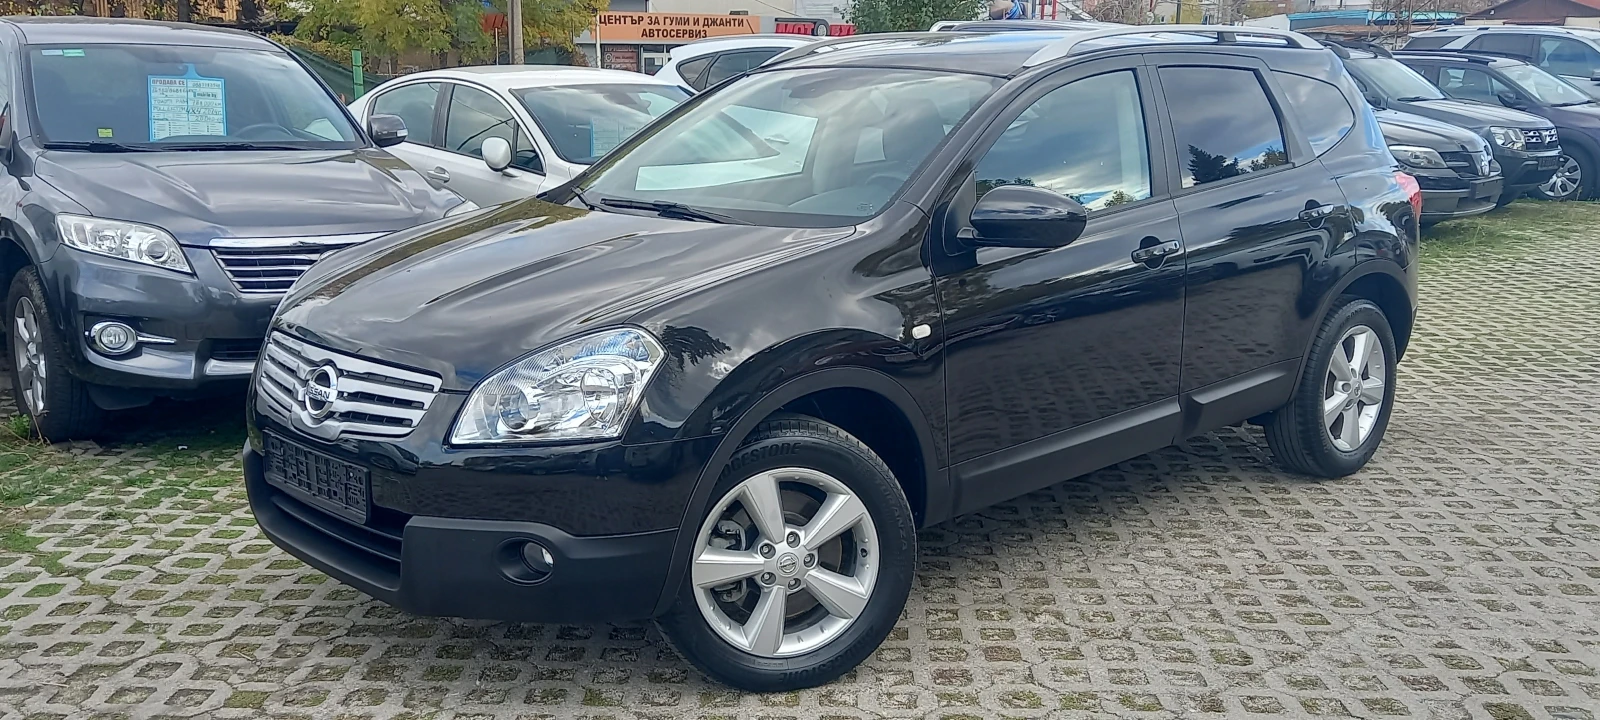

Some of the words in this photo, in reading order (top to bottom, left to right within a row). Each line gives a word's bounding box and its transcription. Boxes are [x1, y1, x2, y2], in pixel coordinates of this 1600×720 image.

[599, 14, 644, 27] ЦЕНТЪР
[647, 15, 660, 26] ЗА
[663, 16, 690, 27] ГУМИ
[693, 17, 700, 26] И
[702, 17, 744, 28] ДЖАНТИ
[641, 28, 708, 39] АВТОСЕРВИЗ
[719, 442, 802, 481] DGESTONE
